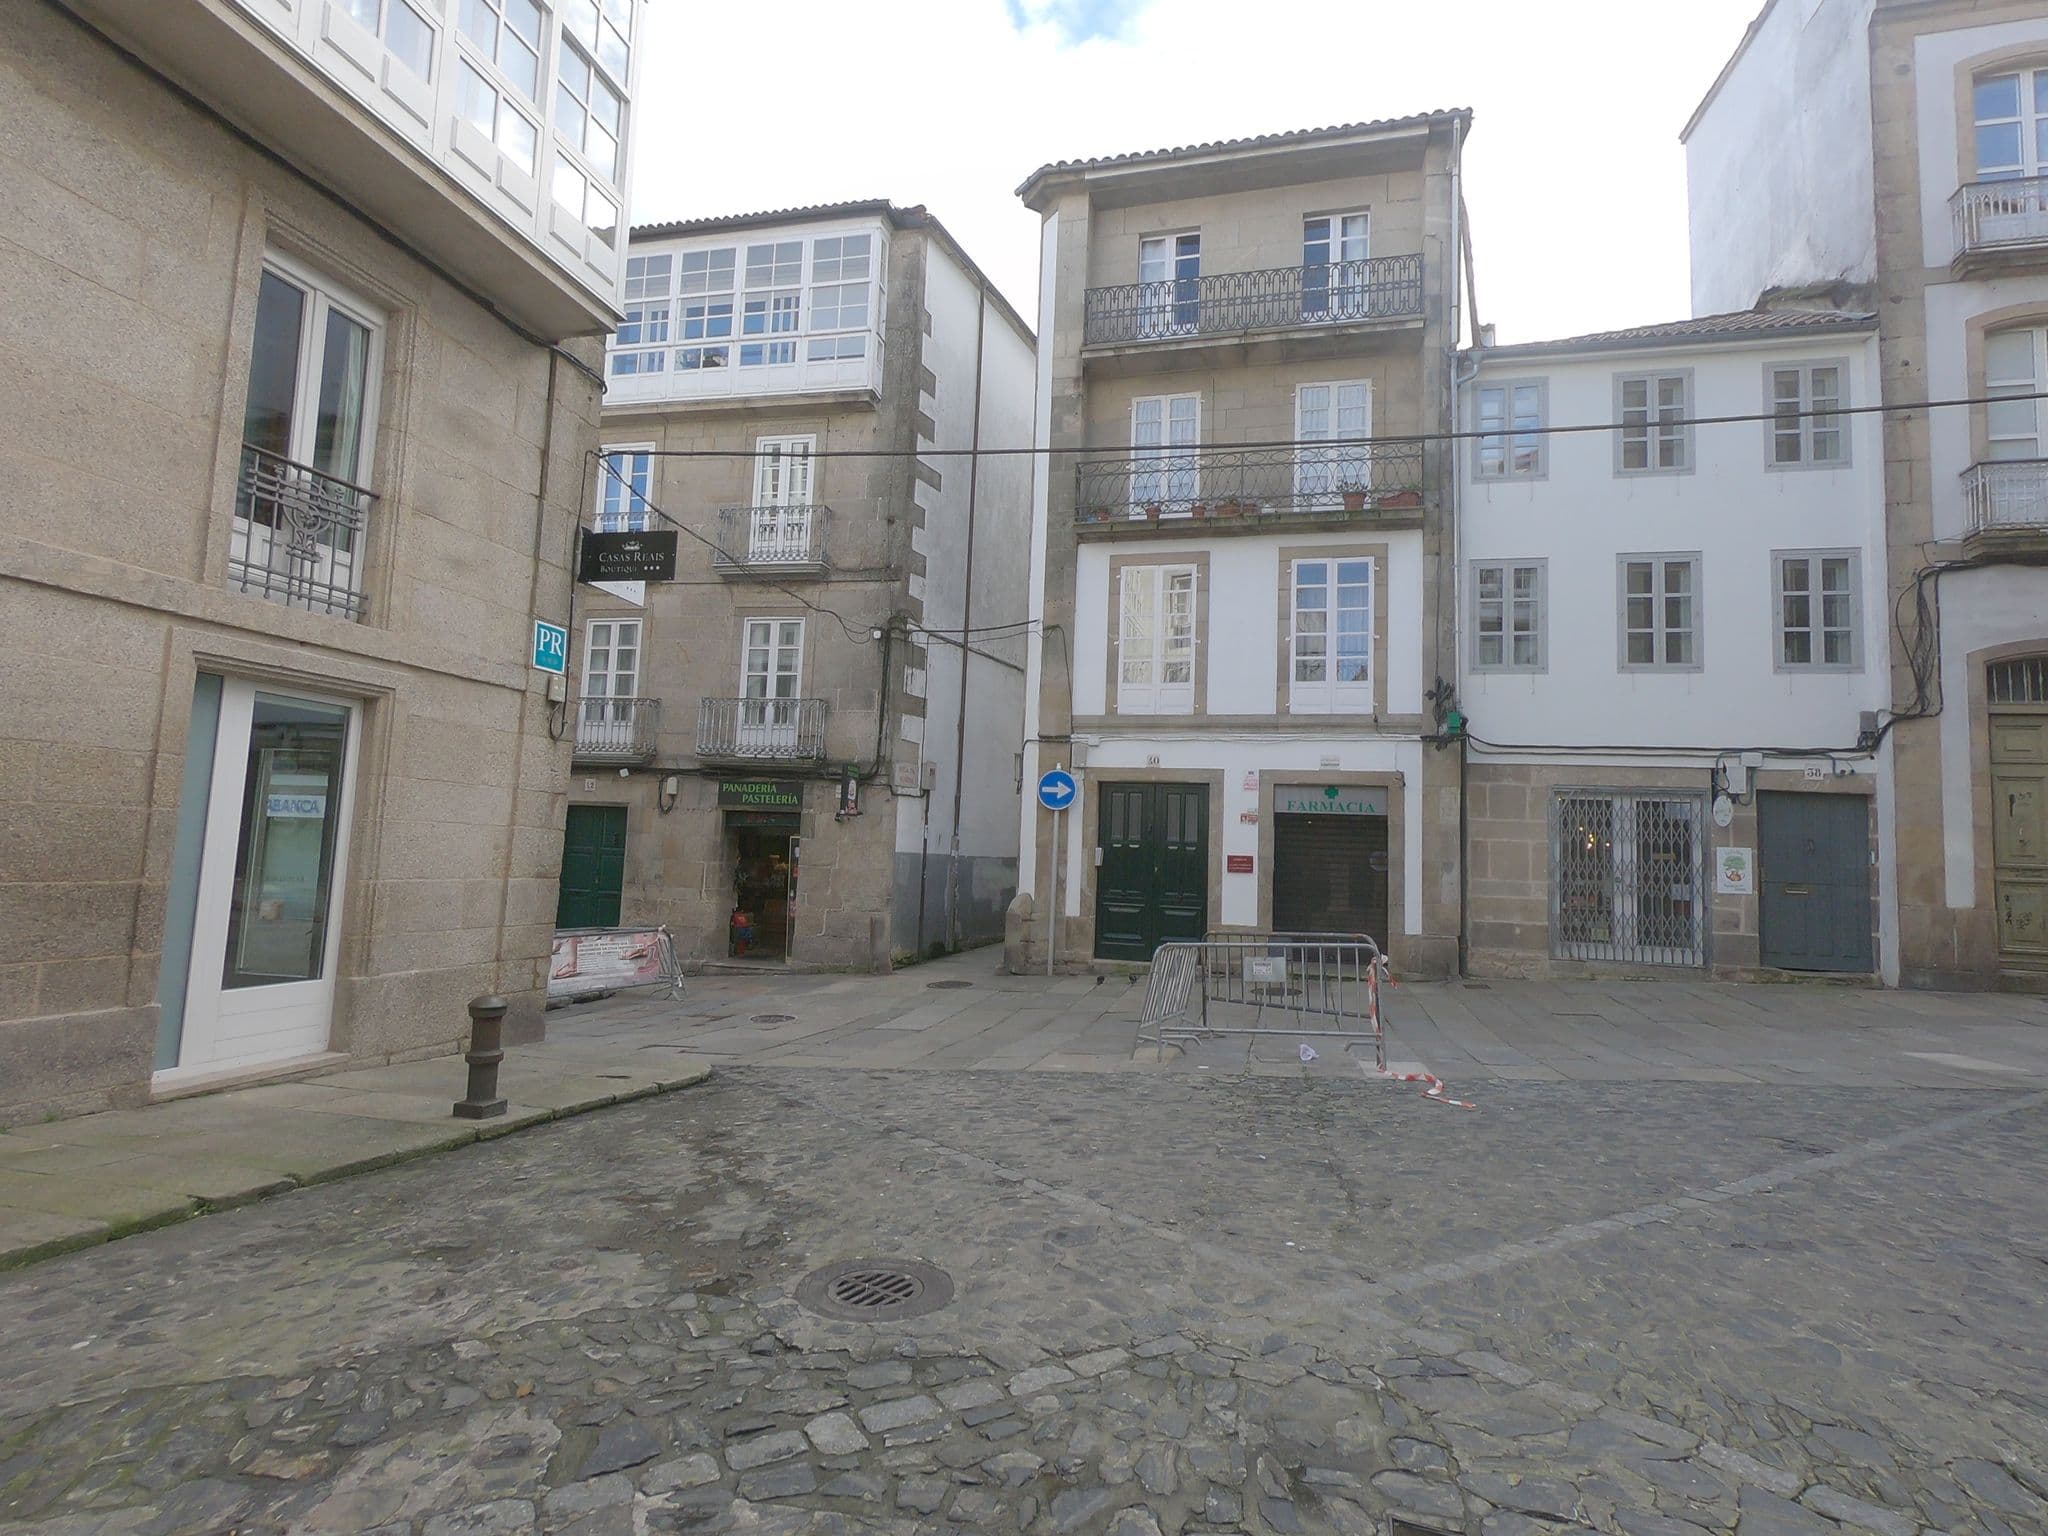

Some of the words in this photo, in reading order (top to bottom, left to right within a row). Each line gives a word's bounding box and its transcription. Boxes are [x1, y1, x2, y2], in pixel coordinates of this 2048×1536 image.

[598, 552, 631, 562] CASAS
[634, 551, 665, 562] REAIS
[537, 627, 562, 657] PR
[722, 782, 777, 794] PANADERÍA
[742, 792, 799, 805] PASTELERÍA
[1287, 800, 1376, 813] FARMACIA
